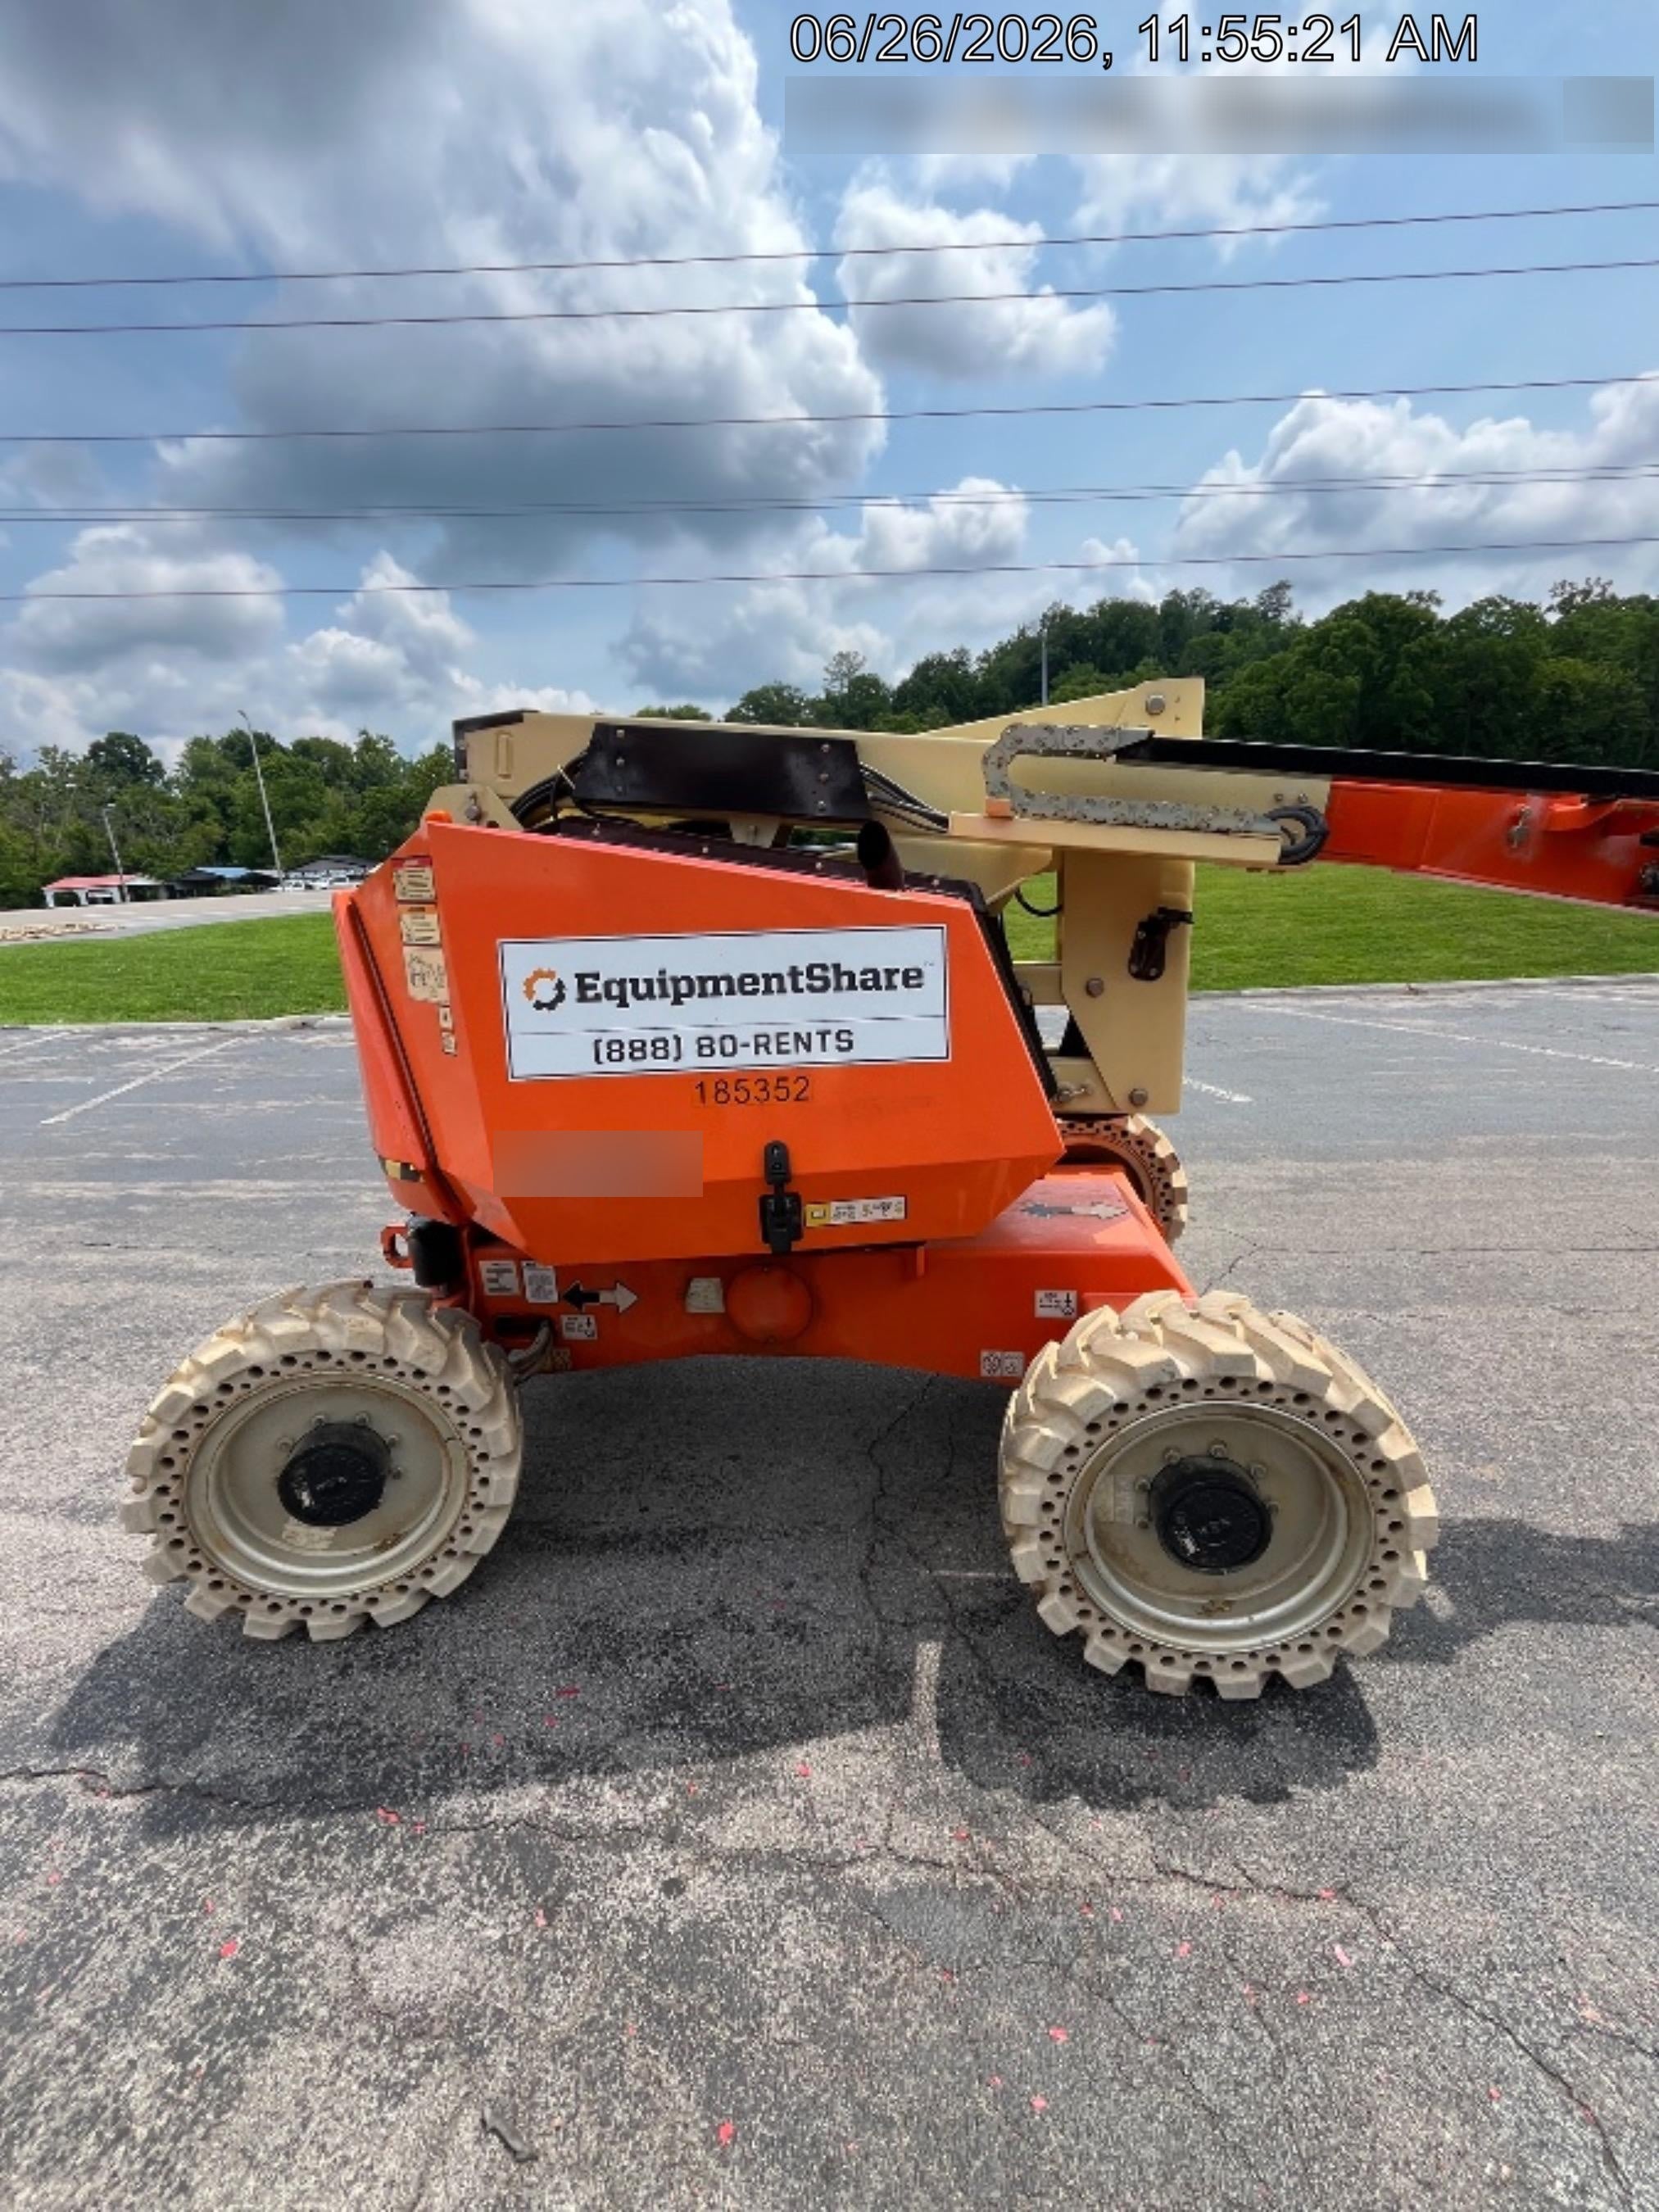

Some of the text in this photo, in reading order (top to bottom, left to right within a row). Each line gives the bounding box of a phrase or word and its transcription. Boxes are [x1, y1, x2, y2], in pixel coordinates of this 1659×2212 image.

[574, 962, 925, 1009] EquipmentShare
[593, 1029, 854, 1064] (888) 80-RENTS
[695, 1076, 809, 1104] 185352
